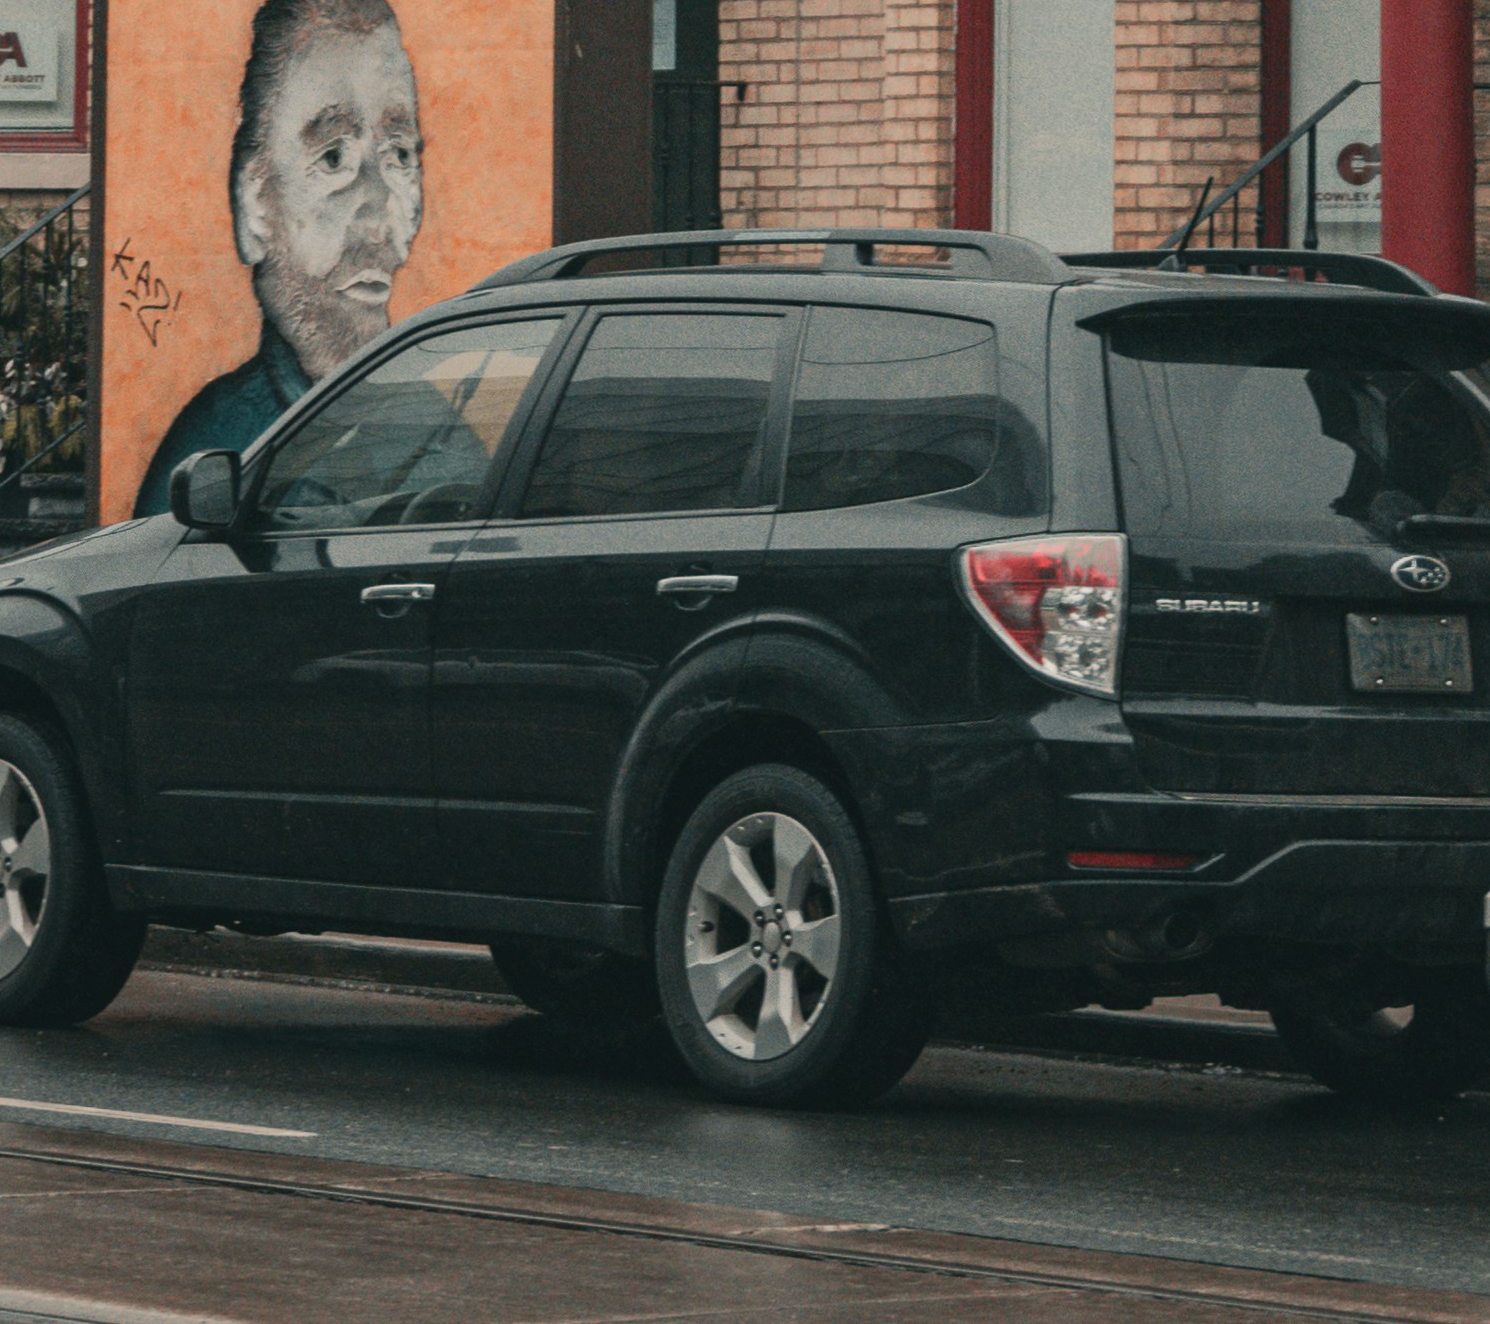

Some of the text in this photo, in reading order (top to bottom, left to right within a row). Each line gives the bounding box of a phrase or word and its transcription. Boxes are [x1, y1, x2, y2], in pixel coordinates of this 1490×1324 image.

[4, 74, 46, 83] ABBOTT
[1314, 192, 1369, 201] COWLEY
[1154, 598, 1260, 613] SUBARU
